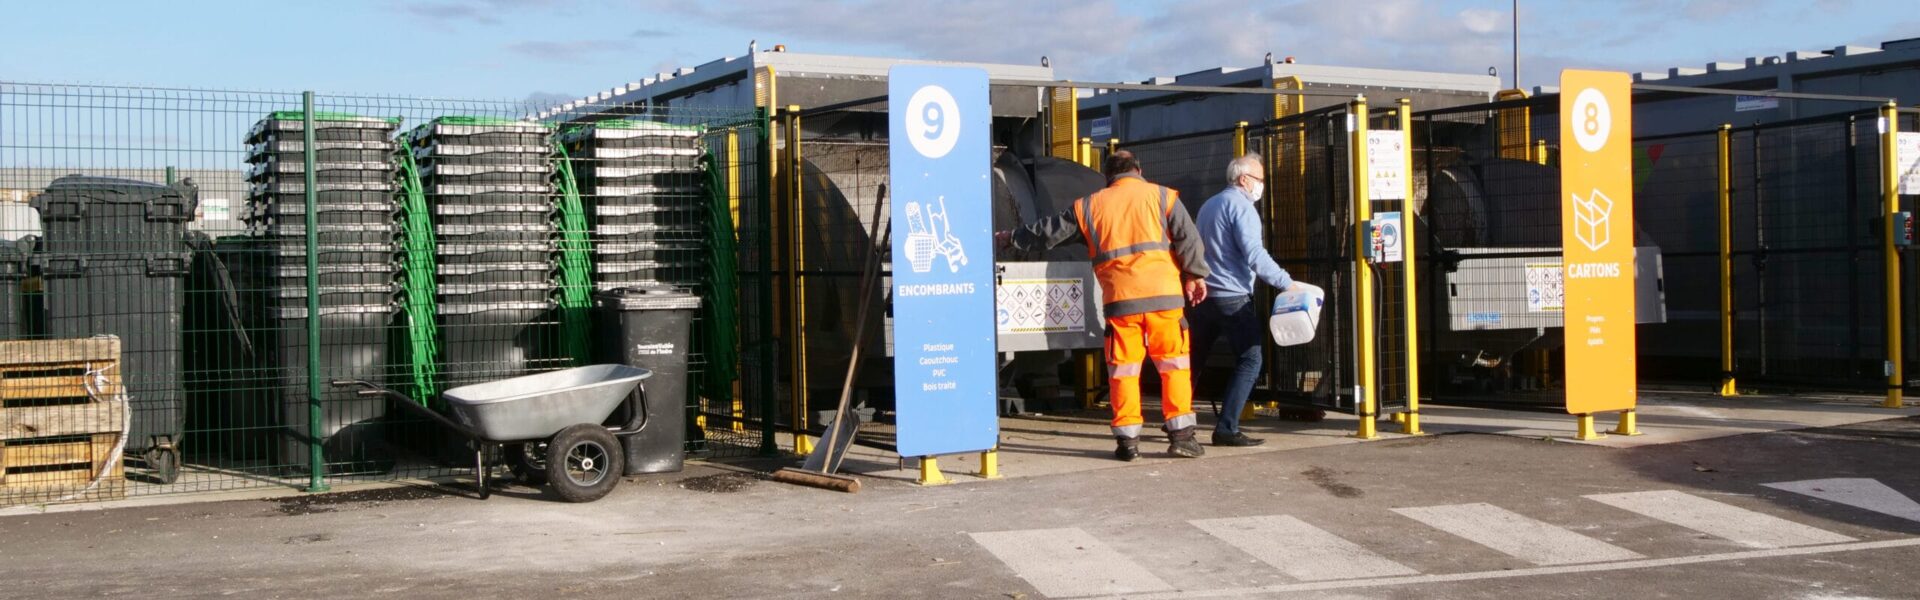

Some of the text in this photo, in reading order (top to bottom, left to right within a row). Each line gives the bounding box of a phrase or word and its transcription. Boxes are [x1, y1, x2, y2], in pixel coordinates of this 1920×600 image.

[922, 101, 944, 140] 9
[1584, 102, 1598, 136] 8
[1568, 263, 1620, 279] CARTONS
[899, 282, 975, 296] ENCOMBRANTS
[923, 343, 954, 352] Plastique
[919, 355, 959, 365] Caoutchouc
[932, 368, 947, 377] PVC
[923, 382, 938, 391] Bois
